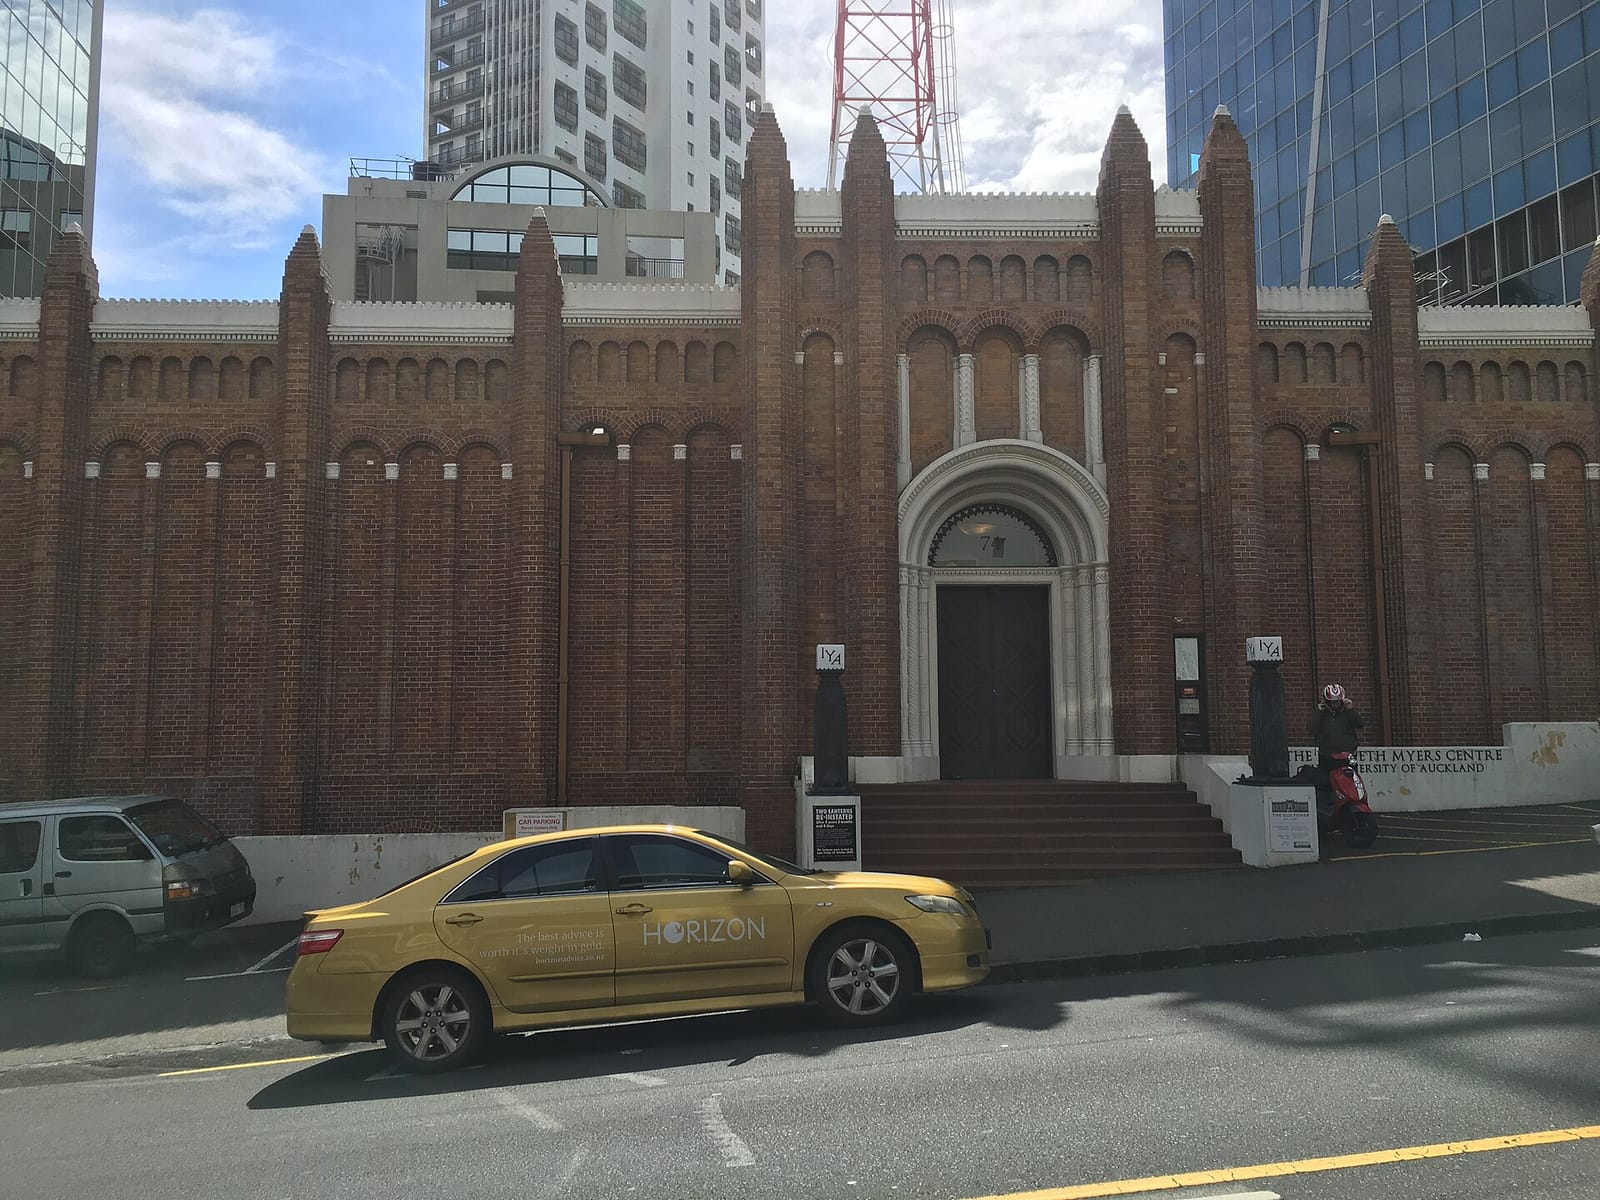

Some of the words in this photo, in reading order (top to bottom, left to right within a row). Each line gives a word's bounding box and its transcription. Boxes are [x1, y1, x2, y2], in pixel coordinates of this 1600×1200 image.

[821, 646, 841, 665] IYA
[1259, 639, 1279, 657] IYA
[1287, 750, 1313, 762] THE
[1392, 749, 1442, 762] MYERS
[1445, 749, 1503, 761] CENTRE
[1357, 763, 1397, 774] ERSITY
[1401, 763, 1416, 773] OF
[1419, 763, 1485, 773] AUCKLAND
[517, 933, 537, 944] The
[538, 931, 560, 941] best
[561, 929, 593, 941] advice
[643, 915, 766, 946] HORIZON
[479, 947, 510, 959] worth
[531, 943, 566, 957] weight
[567, 942, 578, 954] in
